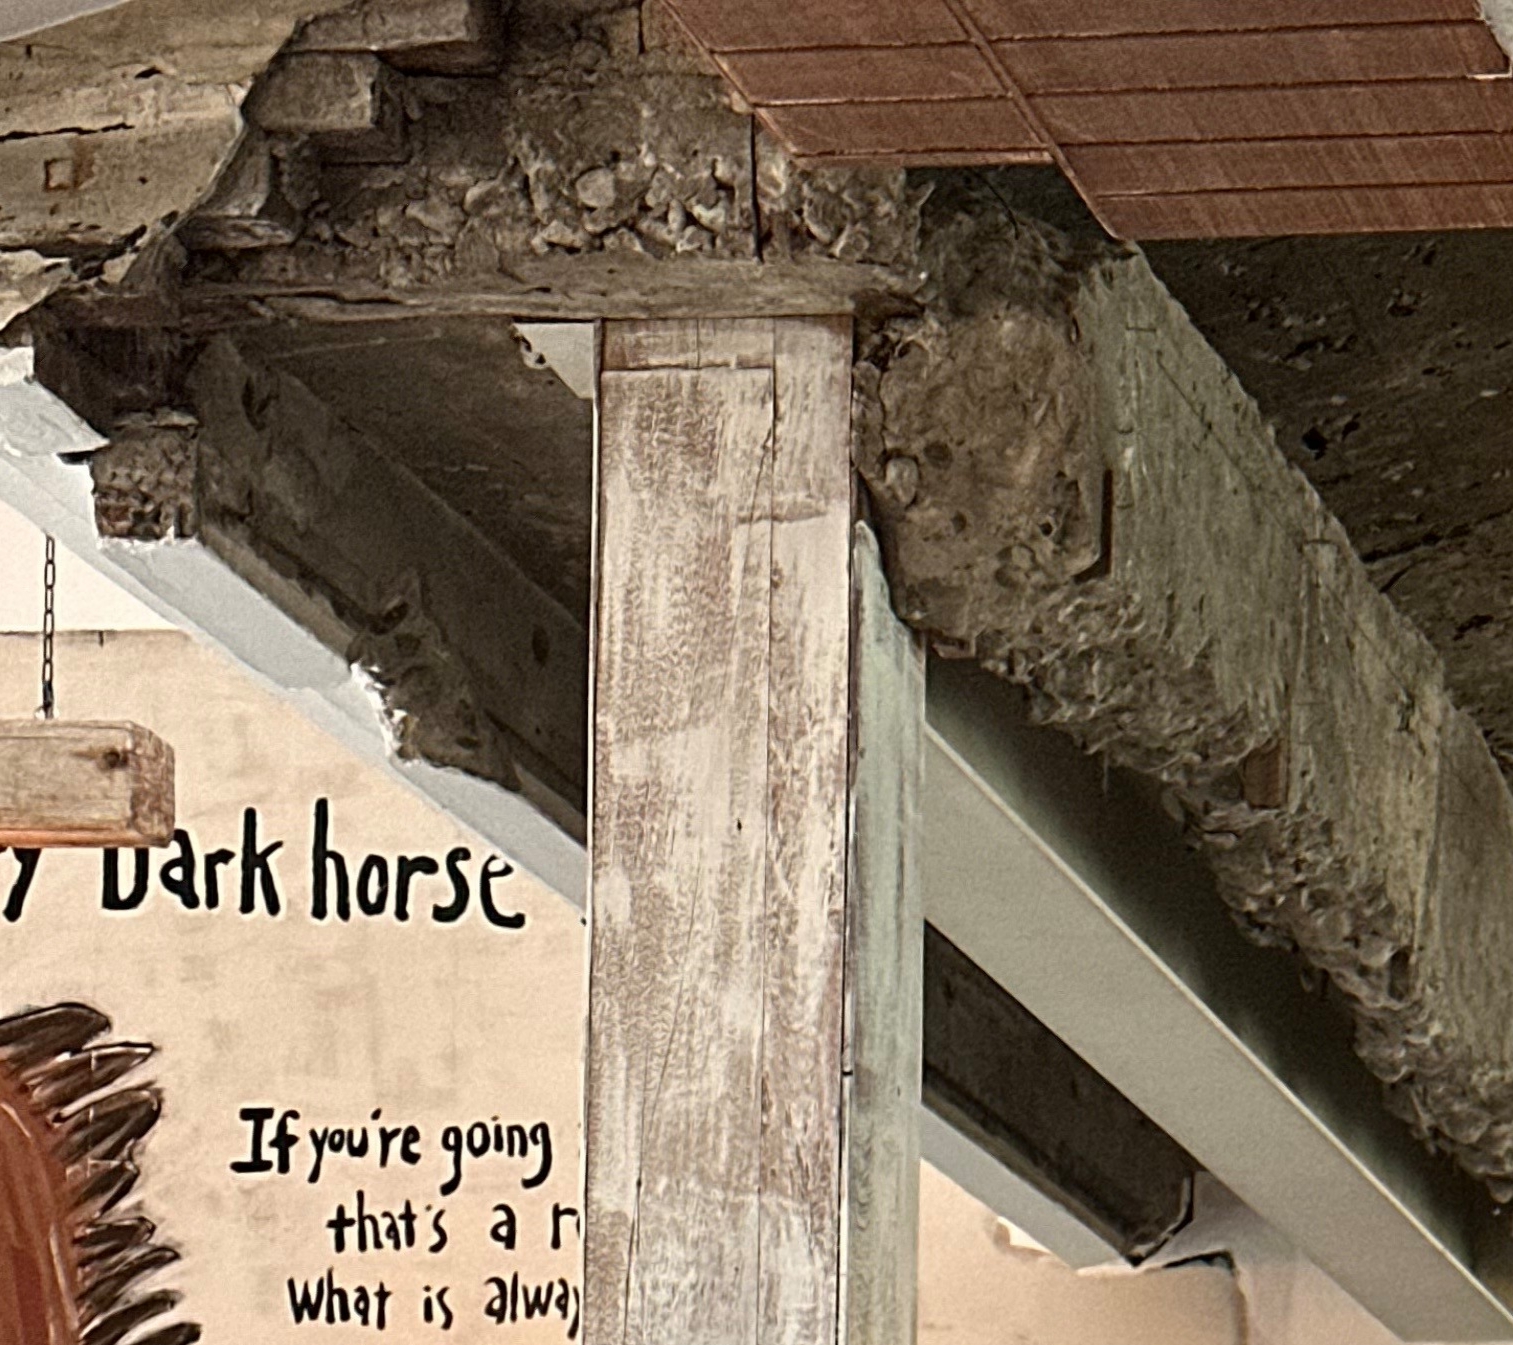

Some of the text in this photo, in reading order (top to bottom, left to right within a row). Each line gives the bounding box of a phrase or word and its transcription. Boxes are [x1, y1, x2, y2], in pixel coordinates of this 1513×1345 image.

[312, 798, 526, 928] horse
[230, 1108, 553, 1195] If you're going
[327, 1190, 448, 1253] that's
[490, 1204, 516, 1250] a
[423, 1285, 453, 1330] is
